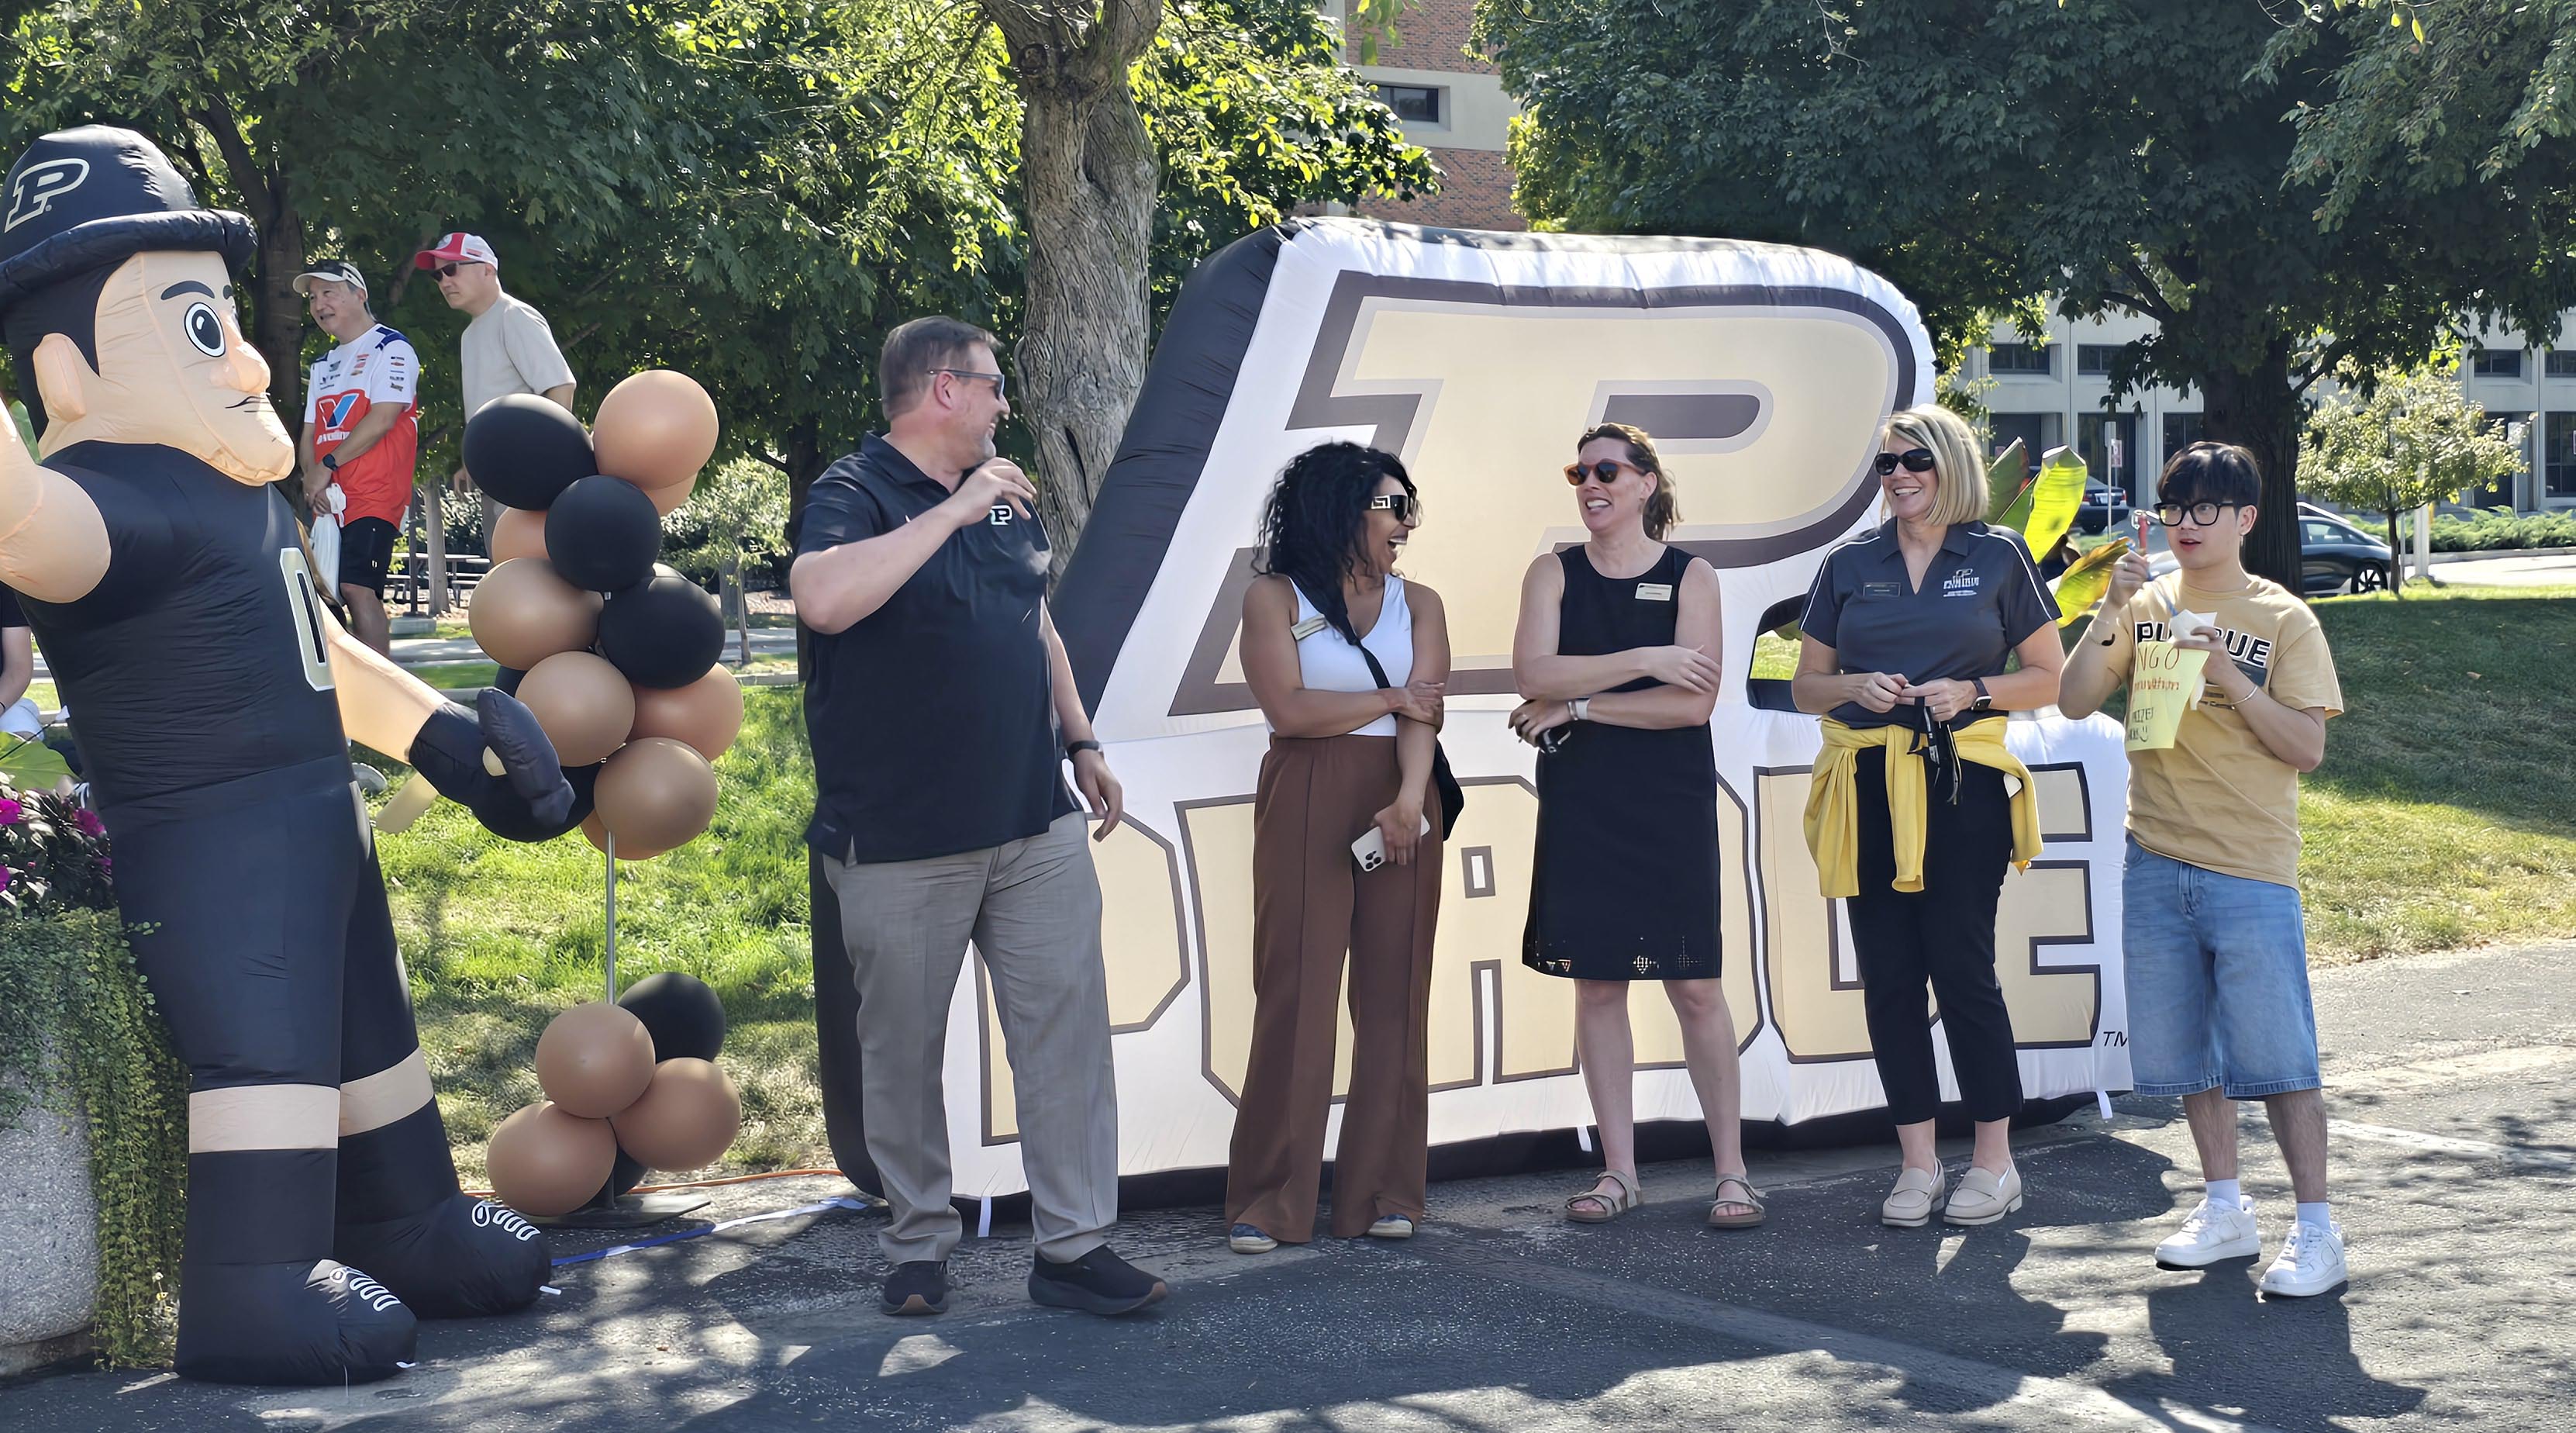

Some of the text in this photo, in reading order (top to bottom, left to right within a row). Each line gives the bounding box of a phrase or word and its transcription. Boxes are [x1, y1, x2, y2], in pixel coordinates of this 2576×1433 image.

[5, 157, 90, 233] P
[989, 504, 1013, 526] P
[1167, 268, 1917, 719] P
[2135, 620, 2273, 669] PUUE
